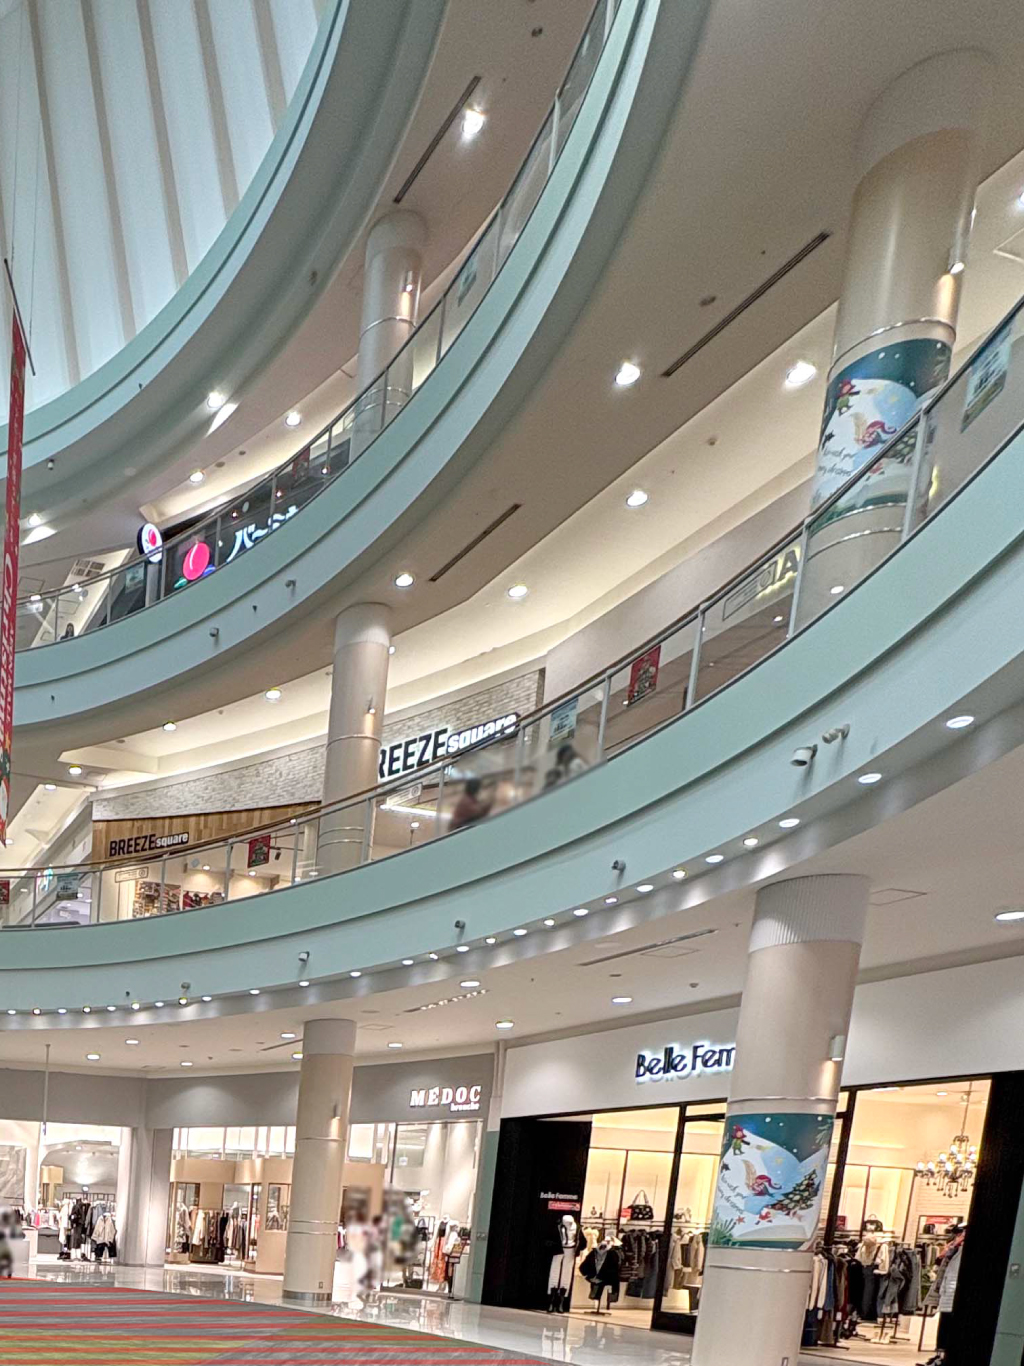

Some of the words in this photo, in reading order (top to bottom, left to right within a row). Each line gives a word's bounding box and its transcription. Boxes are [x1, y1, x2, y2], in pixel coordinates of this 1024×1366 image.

[446, 713, 518, 753] square
[109, 833, 156, 857] BREEZE
[155, 832, 189, 849] square
[635, 1046, 688, 1078] Belle
